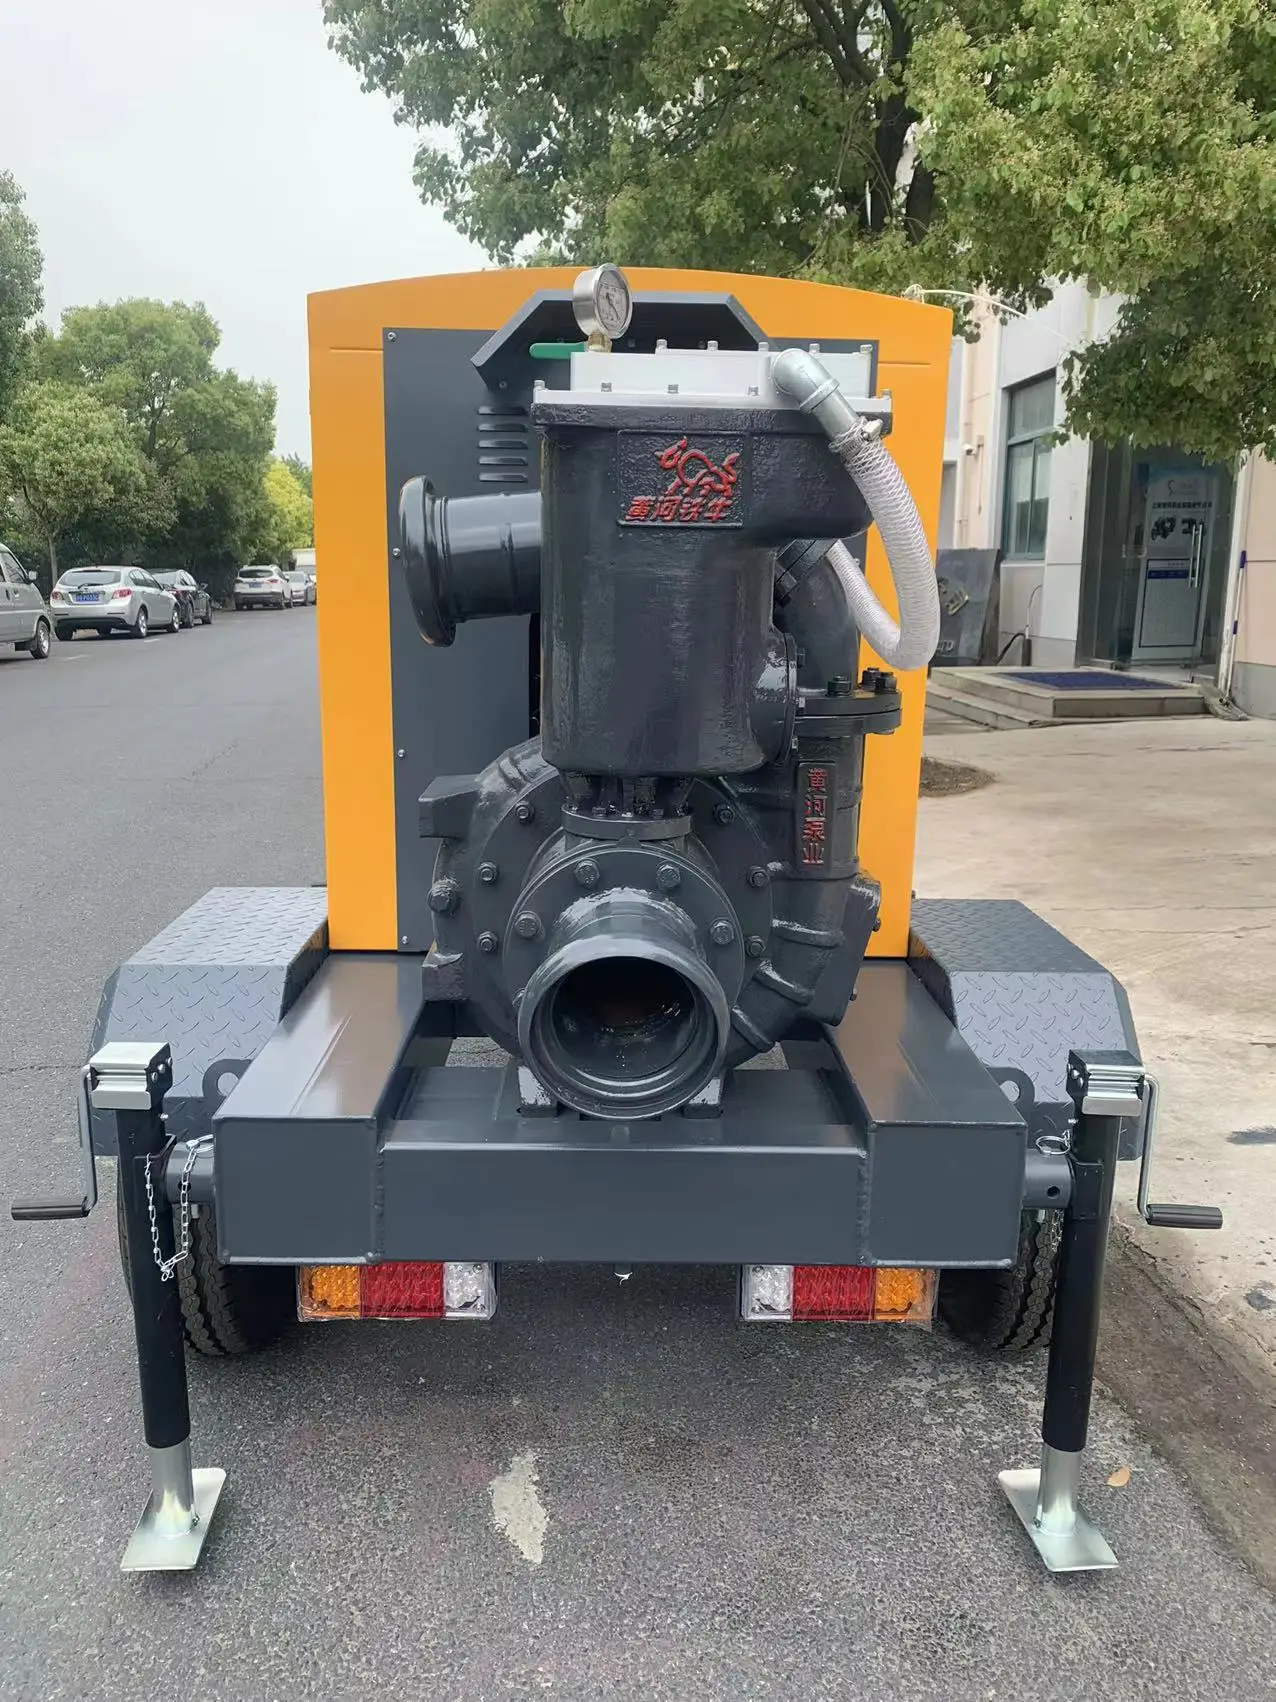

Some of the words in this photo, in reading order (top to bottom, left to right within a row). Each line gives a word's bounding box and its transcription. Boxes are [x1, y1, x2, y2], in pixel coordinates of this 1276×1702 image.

[625, 495, 733, 521] 黄河铁牛
[803, 767, 827, 864] 黄河泵业
